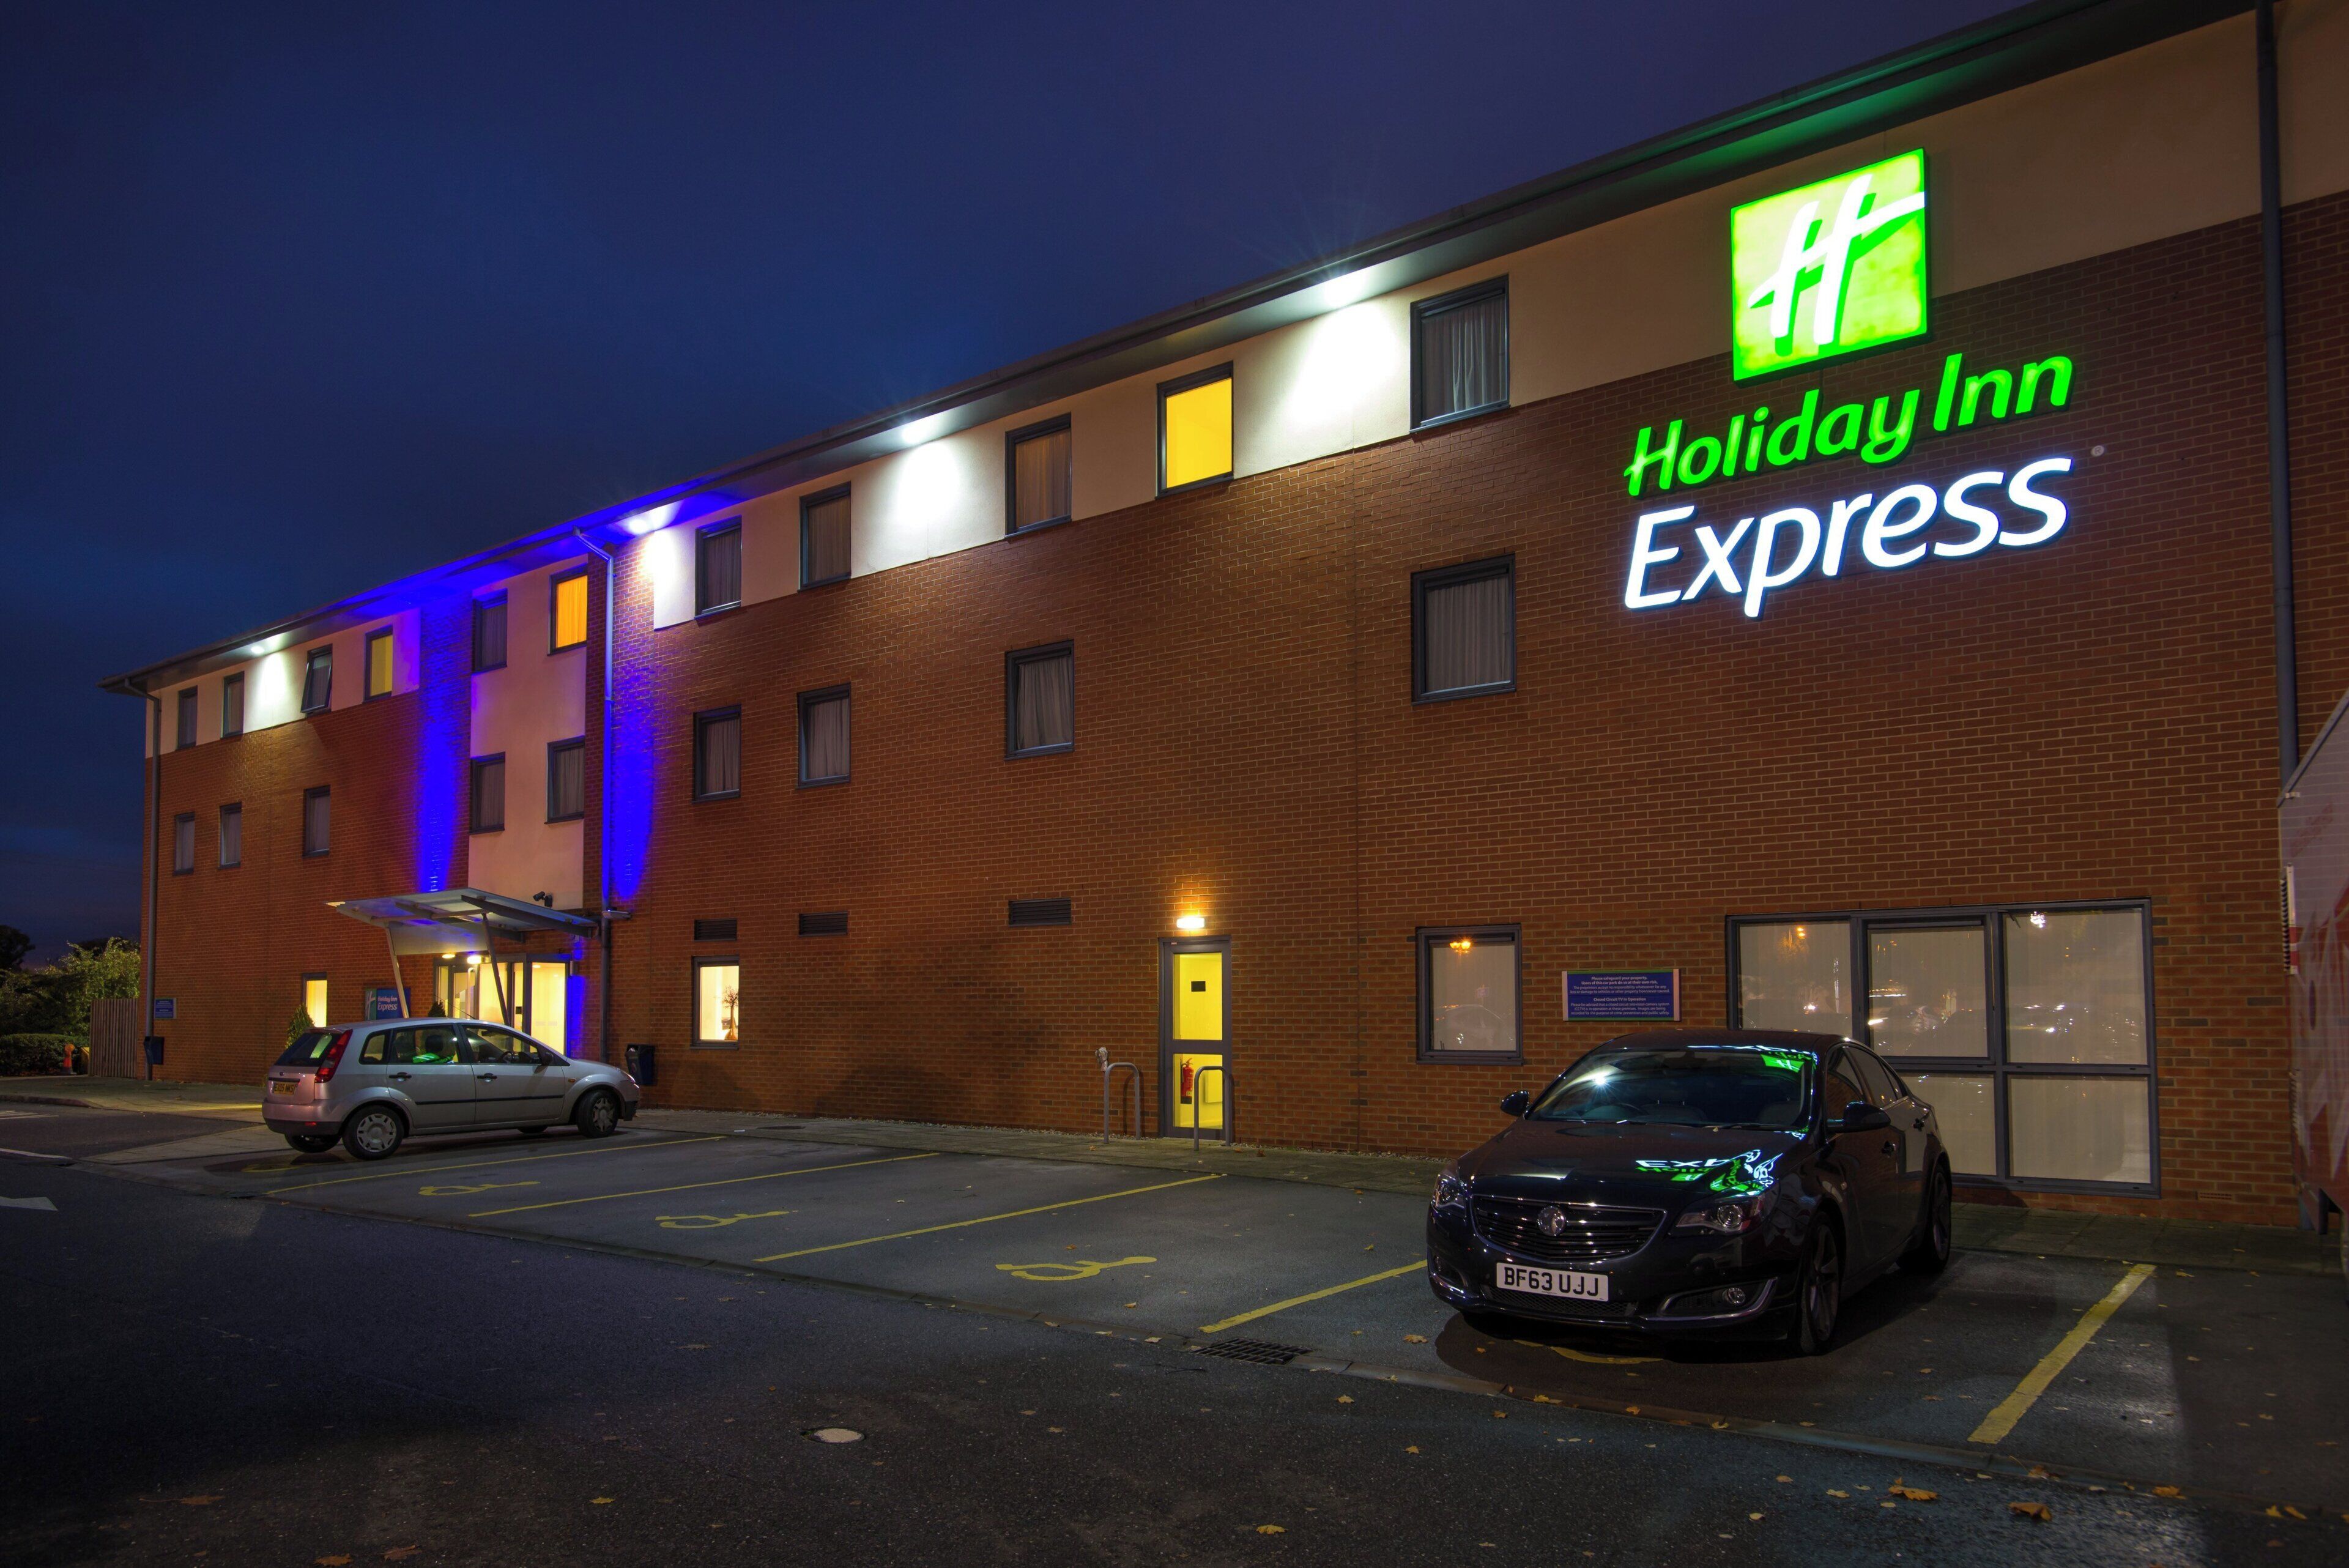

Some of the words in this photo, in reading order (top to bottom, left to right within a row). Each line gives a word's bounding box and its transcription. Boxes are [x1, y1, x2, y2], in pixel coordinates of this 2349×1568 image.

[1624, 388, 1920, 496] Holiday
[1932, 352, 2073, 431] Inn
[1624, 456, 2073, 617] Express
[377, 1002, 398, 1011] Express
[1504, 1266, 1553, 1291] BF63
[1559, 1273, 1598, 1296] UJJ
